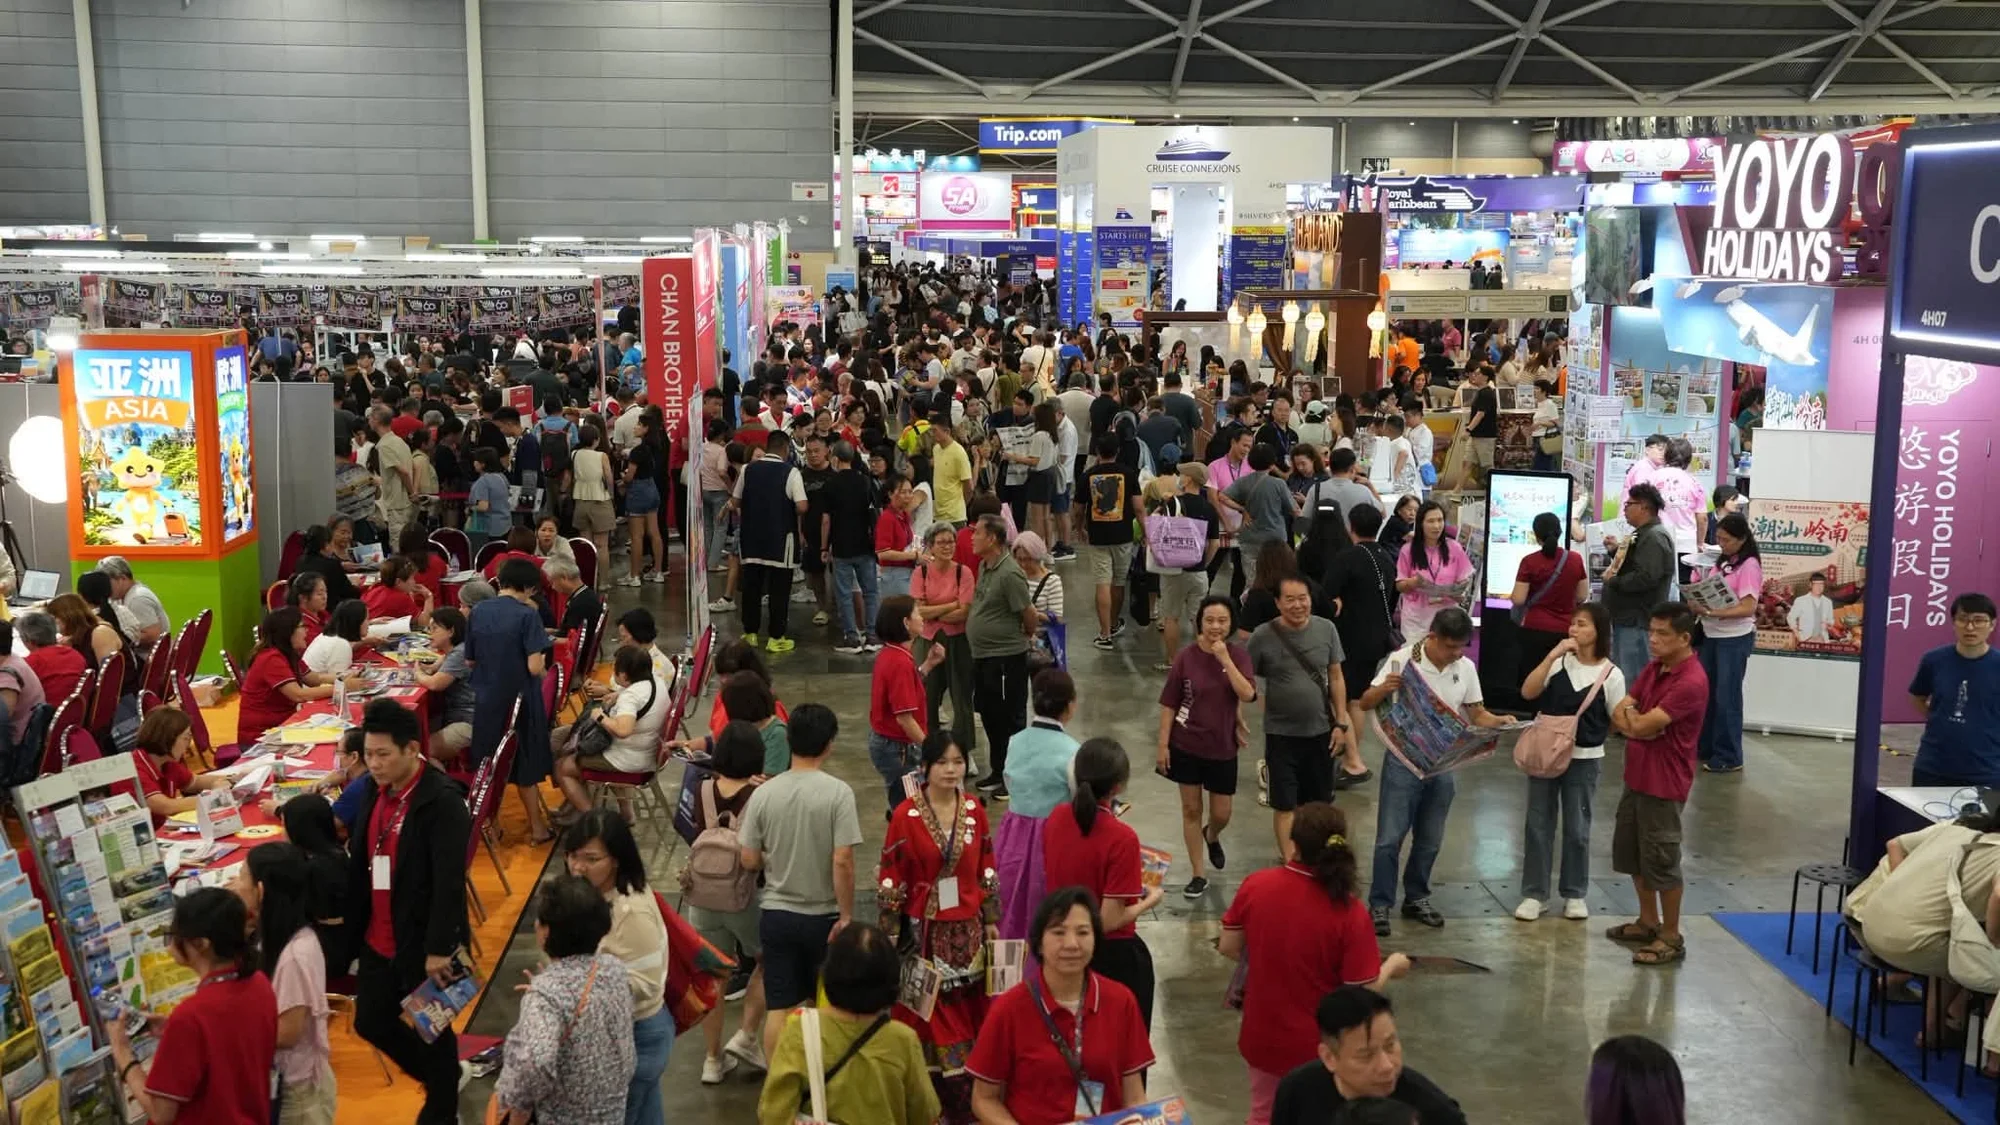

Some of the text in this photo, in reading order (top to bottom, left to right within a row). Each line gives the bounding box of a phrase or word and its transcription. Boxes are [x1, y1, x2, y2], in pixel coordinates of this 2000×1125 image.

[993, 125, 1062, 146] Trip.com
[1146, 164, 1242, 174] CRUISE CONNEXIONS
[1712, 133, 1842, 230] YOYO
[1386, 200, 1437, 209] aribbean
[1100, 231, 1127, 240] STARTS
[1702, 230, 1832, 283] HOLIDAYS
[659, 273, 680, 336] CHAN
[1920, 310, 1948, 327] 4H07
[88, 356, 181, 398] 亚洲
[104, 400, 169, 422] ASIA
[1886, 425, 1933, 630] 悠游假日
[1925, 428, 1961, 627] YOYO HOLIDAYS
